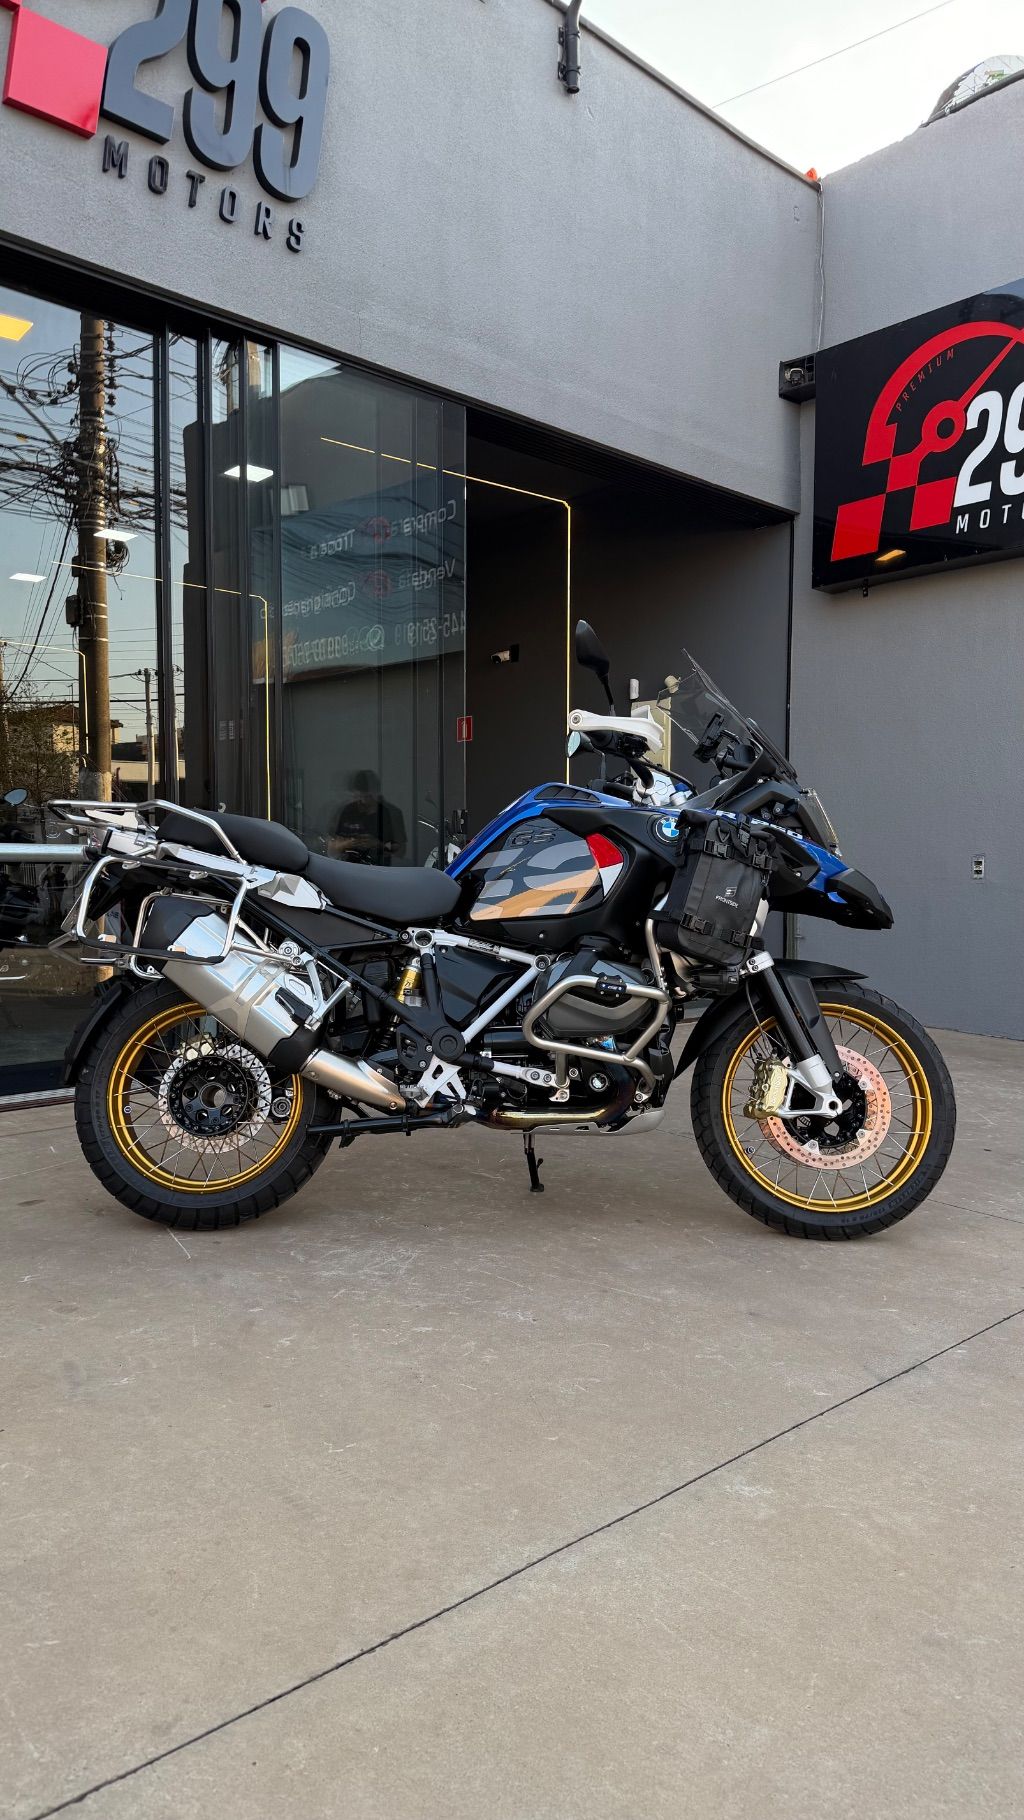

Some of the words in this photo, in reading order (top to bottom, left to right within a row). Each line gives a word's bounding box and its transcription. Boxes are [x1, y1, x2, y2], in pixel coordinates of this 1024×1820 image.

[102, 134, 304, 252] MOTORS
[895, 347, 954, 412] PREMIUM
[955, 501, 1024, 534] MOT
